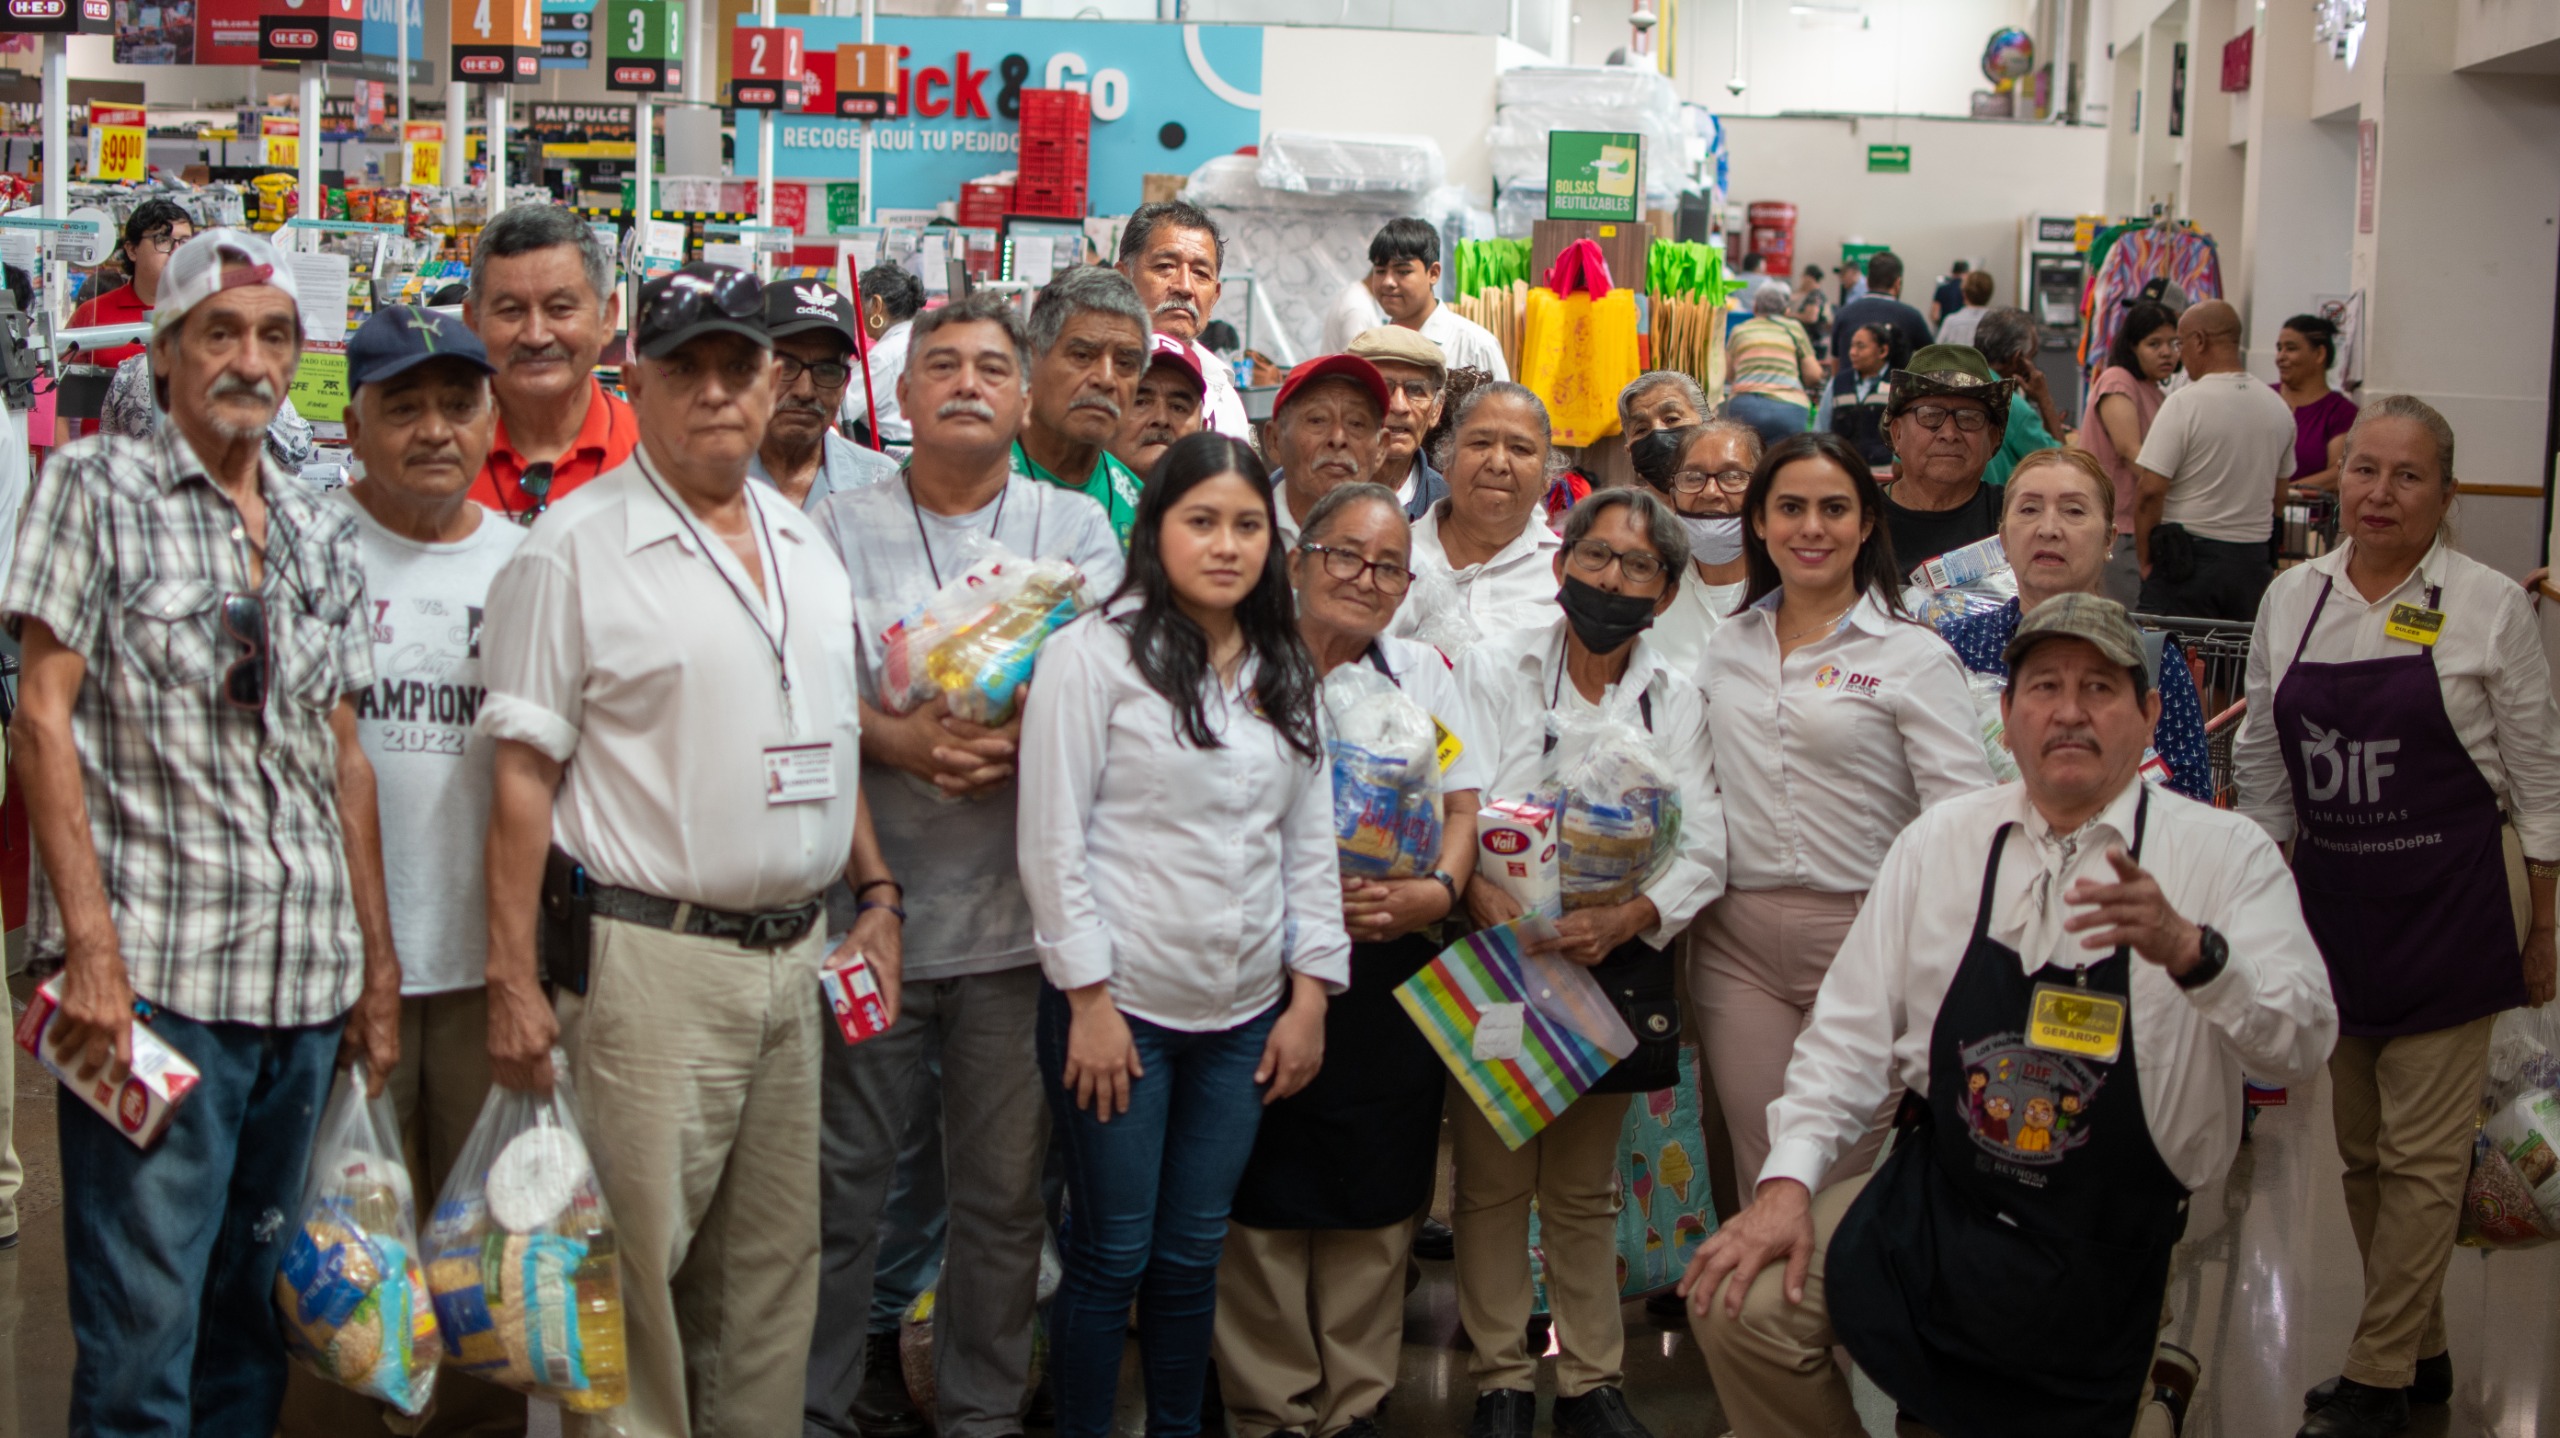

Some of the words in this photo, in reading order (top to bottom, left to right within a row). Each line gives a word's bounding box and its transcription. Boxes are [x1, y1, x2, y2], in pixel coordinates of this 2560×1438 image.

[473, 0, 492, 38] 4
[628, 9, 644, 52] 3
[671, 11, 678, 54] 3
[750, 34, 766, 75] 2
[789, 36, 797, 76] 2
[855, 51, 866, 87] 1
[889, 53, 895, 88] 1
[535, 106, 570, 121] PAN
[573, 107, 631, 123] DULCE
[783, 126, 860, 148] RECOGE
[920, 130, 946, 151] TU
[1555, 179, 1596, 195] BOLSAS
[1554, 195, 1631, 212] REUTILIZABLES
[795, 306, 839, 322] adidas
[1848, 673, 1882, 688] DIF
[382, 724, 465, 755] 2022
[2308, 809, 2409, 825] TAMAULIPAS
[1491, 834, 1519, 850] Vail
[2313, 832, 2443, 855] #MensajerosDePaz
[2041, 1025, 2103, 1044] GERARDO
[2023, 1063, 2054, 1079] DIF
[1994, 1162, 2048, 1184] REYNOSA
